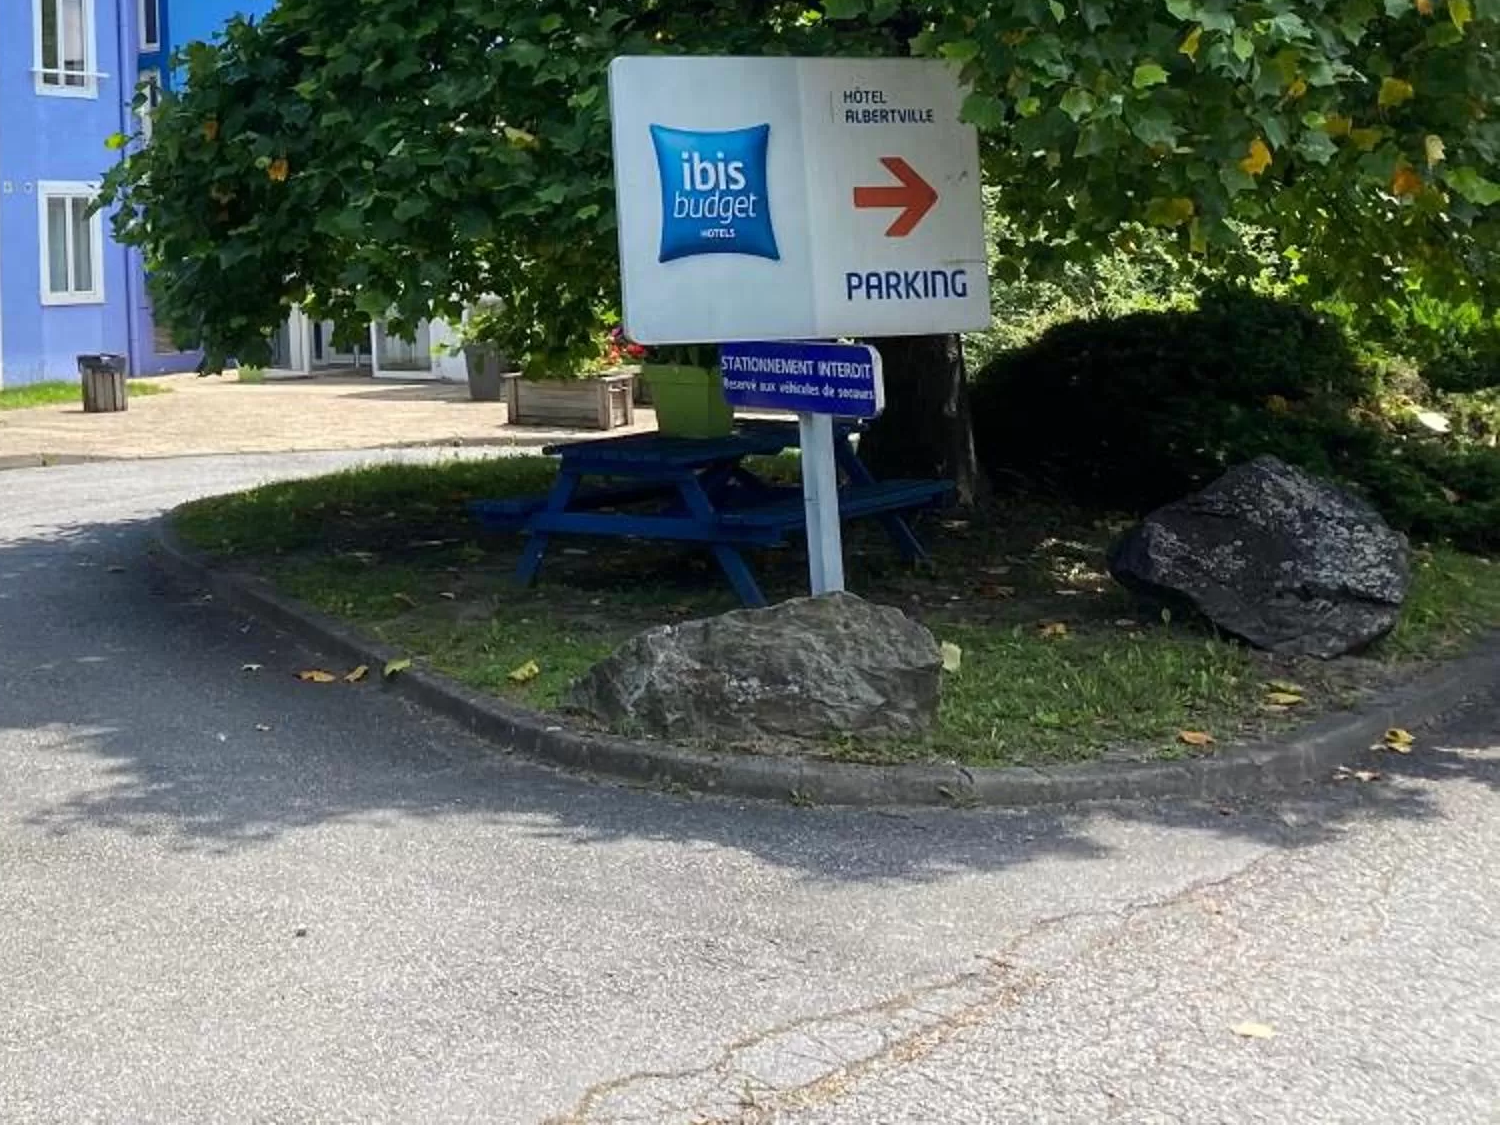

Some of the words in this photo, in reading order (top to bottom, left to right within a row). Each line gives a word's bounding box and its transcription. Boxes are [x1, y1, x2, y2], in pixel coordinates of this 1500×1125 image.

[843, 85, 888, 104] HÔTEL
[845, 108, 935, 124] ALBERTVILLE
[681, 151, 746, 191] ibis
[673, 190, 757, 224] budget
[846, 269, 968, 302] PARKING
[721, 355, 814, 375] STATIONNEMENT
[818, 361, 871, 379] INTERDIT
[760, 382, 776, 392] aux
[822, 383, 835, 398] de
